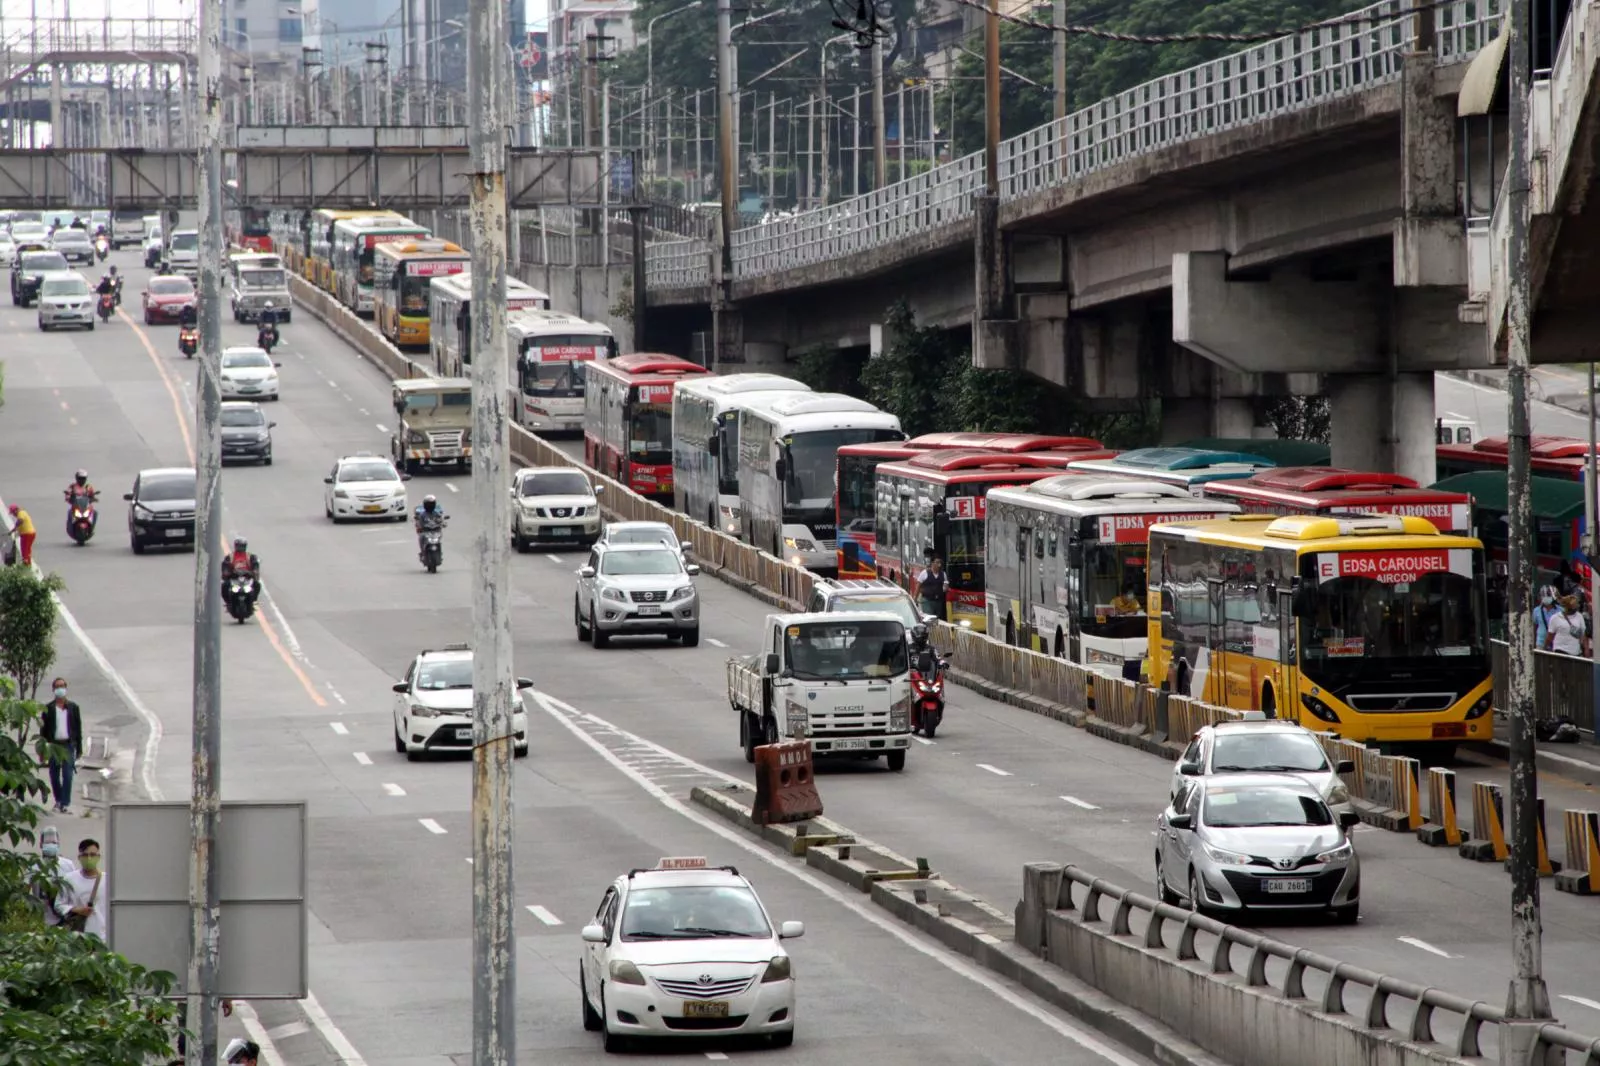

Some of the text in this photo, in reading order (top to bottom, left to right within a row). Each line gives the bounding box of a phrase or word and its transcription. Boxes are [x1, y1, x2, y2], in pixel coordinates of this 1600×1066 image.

[1391, 504, 1451, 517] CAROUSEL
[1115, 516, 1145, 529] EDSA
[1102, 522, 1111, 537] E
[1321, 563, 1333, 577] E
[1342, 555, 1447, 573] EDSA CAROUSEL
[1376, 572, 1417, 583] AIRCON
[1269, 882, 1283, 890] CAU
